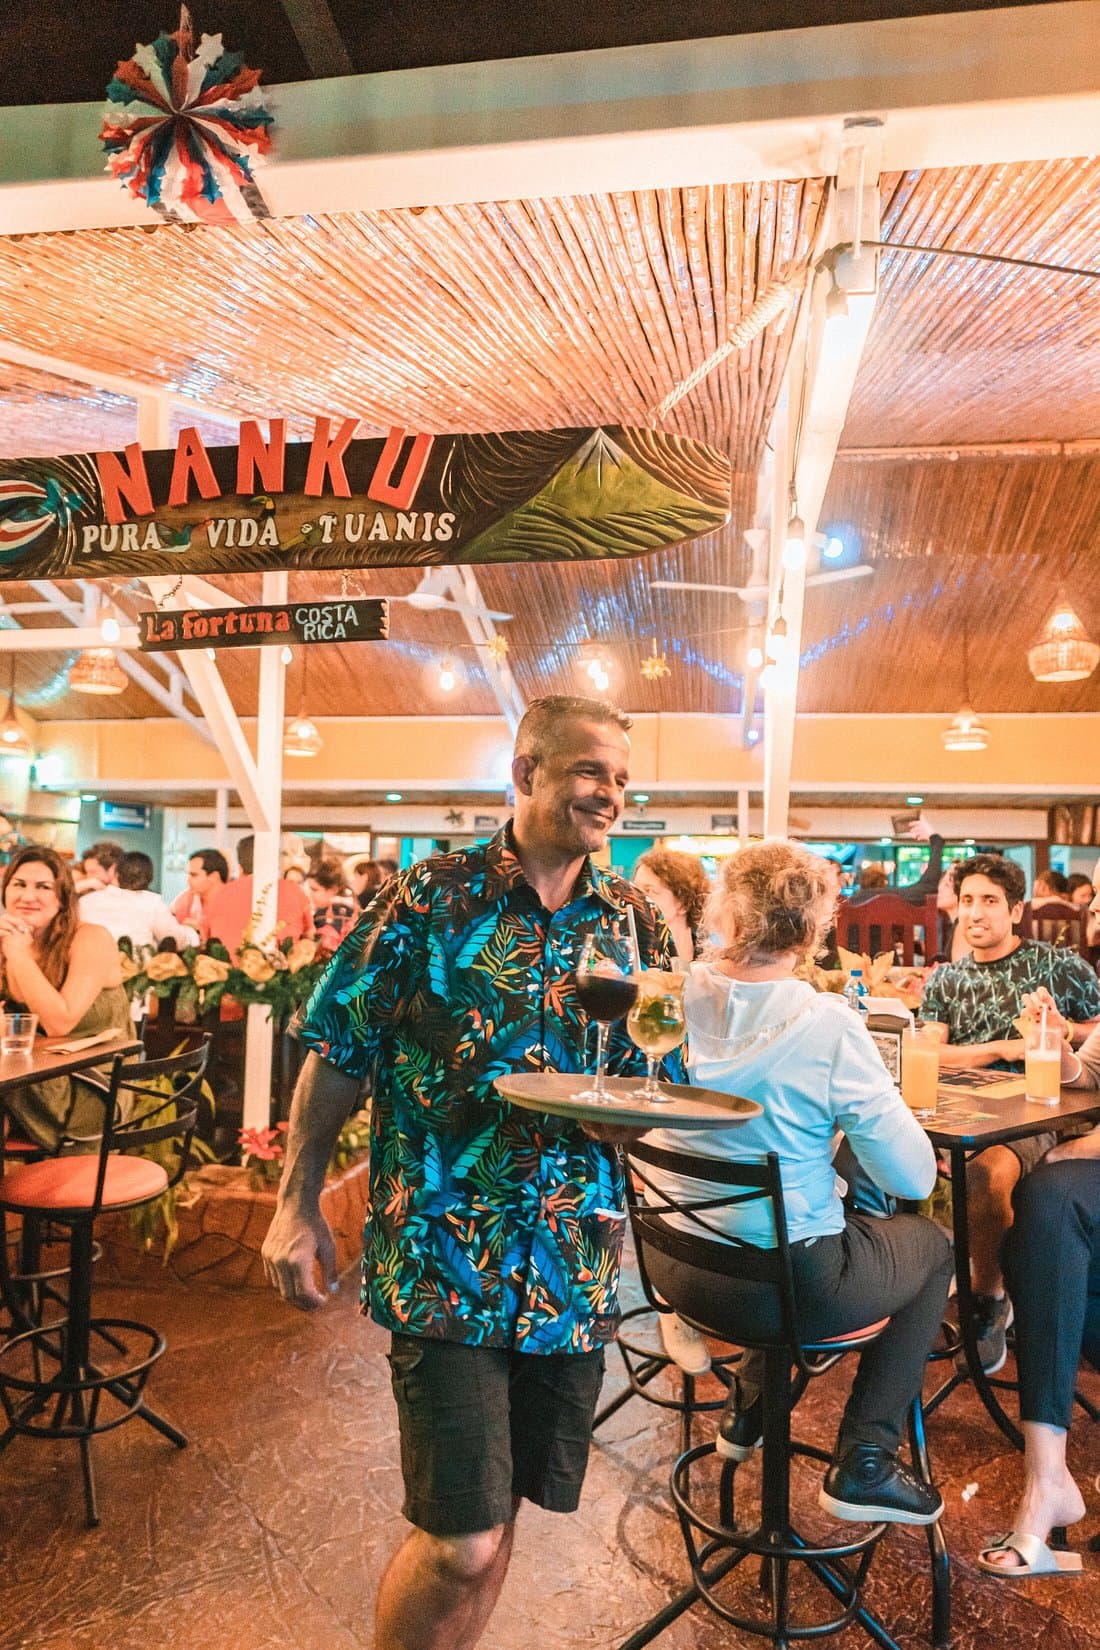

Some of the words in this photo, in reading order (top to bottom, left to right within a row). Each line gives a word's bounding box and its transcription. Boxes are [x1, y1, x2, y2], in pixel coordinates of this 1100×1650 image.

[96, 416, 435, 525] NANKU
[82, 522, 163, 553] PURA
[207, 516, 280, 548] VIDA
[319, 511, 457, 544] TUANIS
[146, 616, 175, 642] La
[181, 610, 290, 640] fortuna
[295, 603, 359, 627] COSTA
[303, 622, 347, 641] RICA
